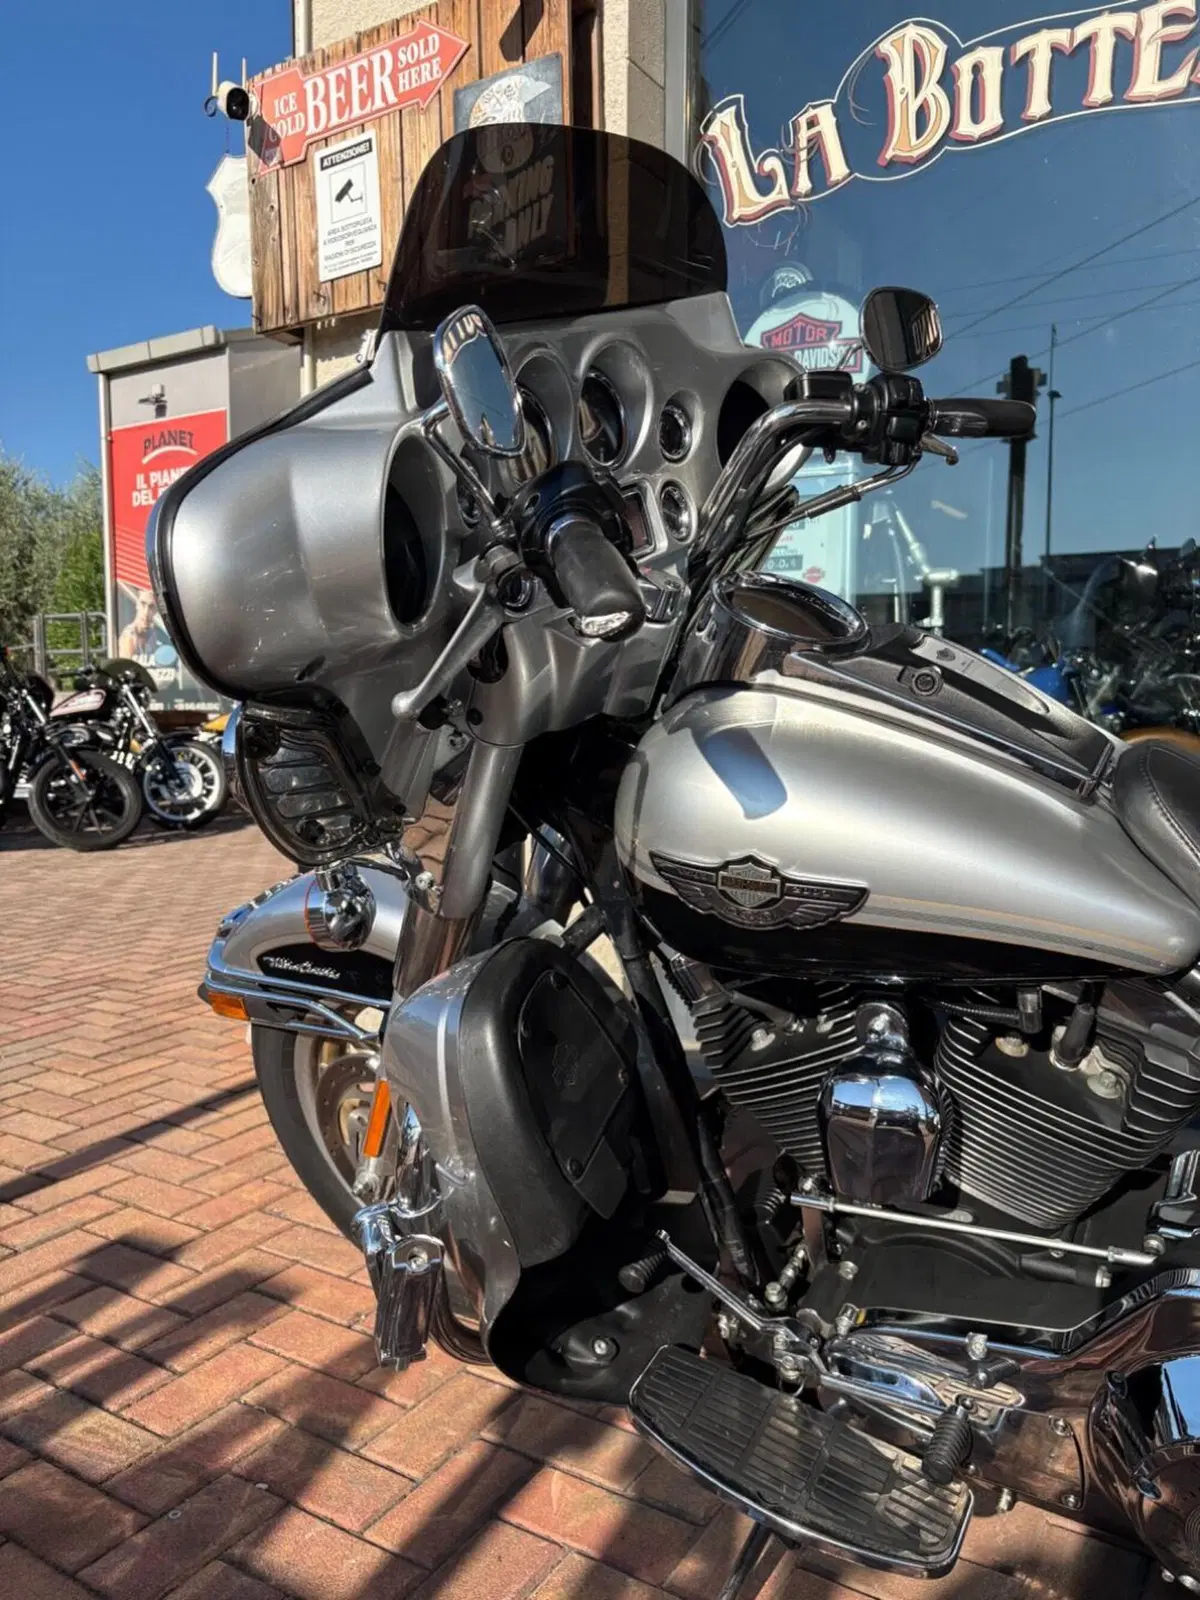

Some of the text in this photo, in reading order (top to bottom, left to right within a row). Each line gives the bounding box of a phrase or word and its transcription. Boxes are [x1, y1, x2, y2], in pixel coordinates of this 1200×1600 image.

[397, 33, 440, 69] SOLD
[397, 57, 442, 94] HERE
[273, 91, 298, 119] ICE
[303, 48, 398, 137] BEER
[702, 104, 851, 225] LA
[876, 0, 1200, 167] BOTTE
[771, 321, 828, 348] MOTOR
[143, 429, 194, 457] PLANET
[136, 473, 148, 490] IL
[132, 488, 156, 508] DEL
